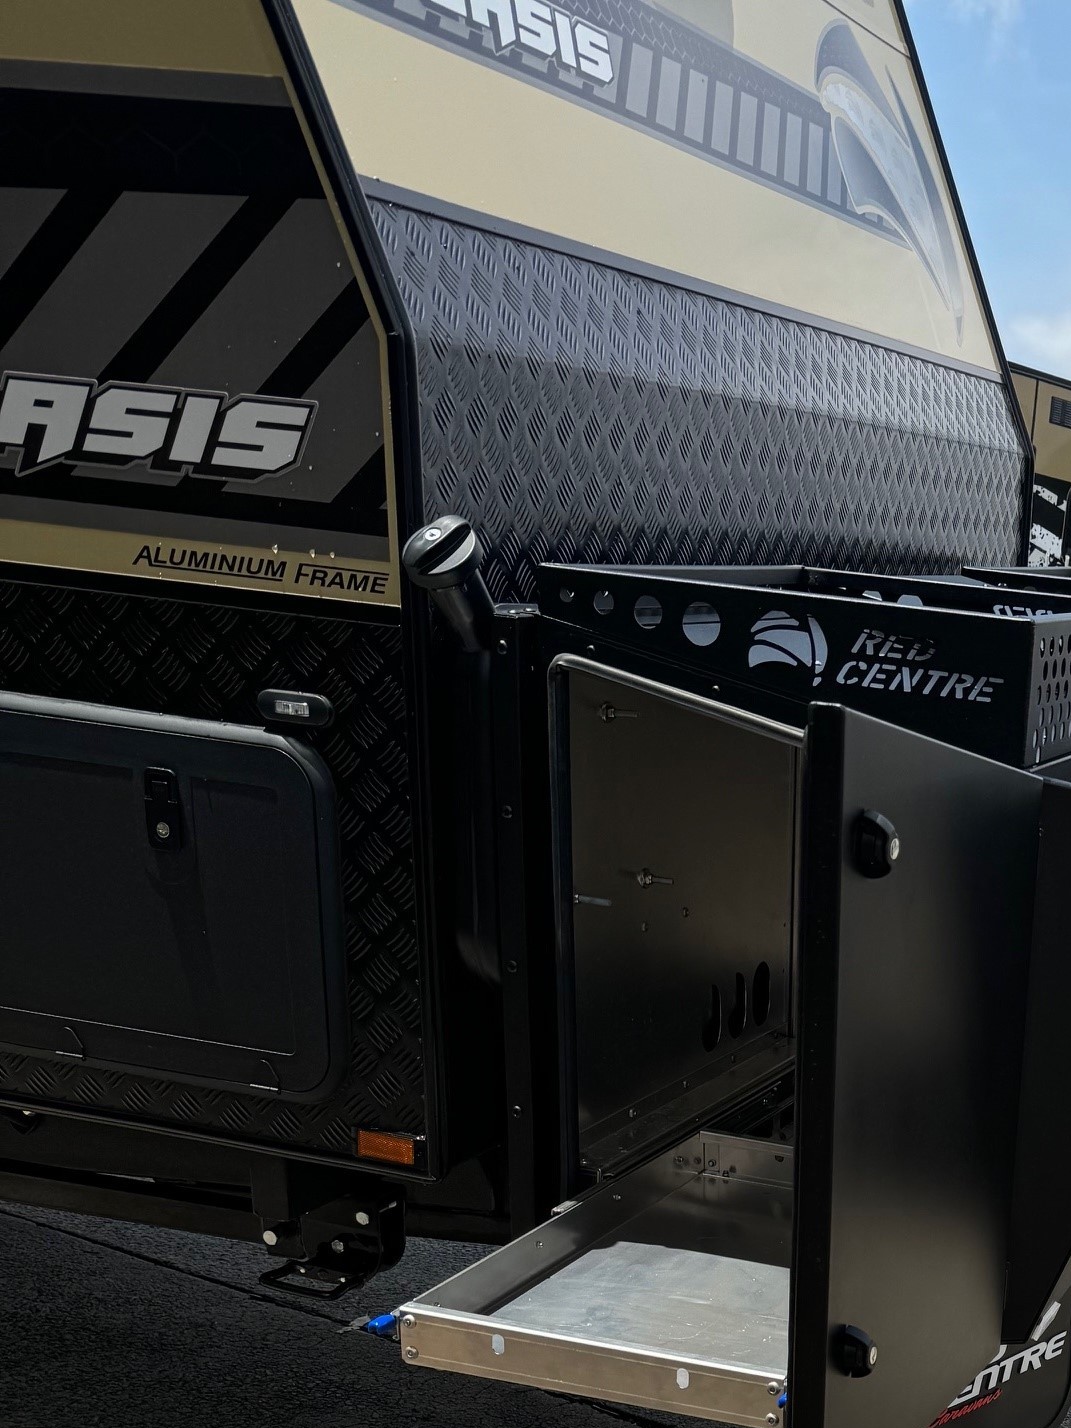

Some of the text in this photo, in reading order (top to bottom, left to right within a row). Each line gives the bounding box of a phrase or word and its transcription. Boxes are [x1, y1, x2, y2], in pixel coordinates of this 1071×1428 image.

[420, 0, 614, 84] ASIS
[0, 376, 312, 472] ASIS
[132, 544, 390, 595] ALUMINIUM FRAME
[851, 628, 936, 662] RED
[836, 660, 1004, 703] CENTRE
[947, 1330, 1068, 1409] ENTRE
